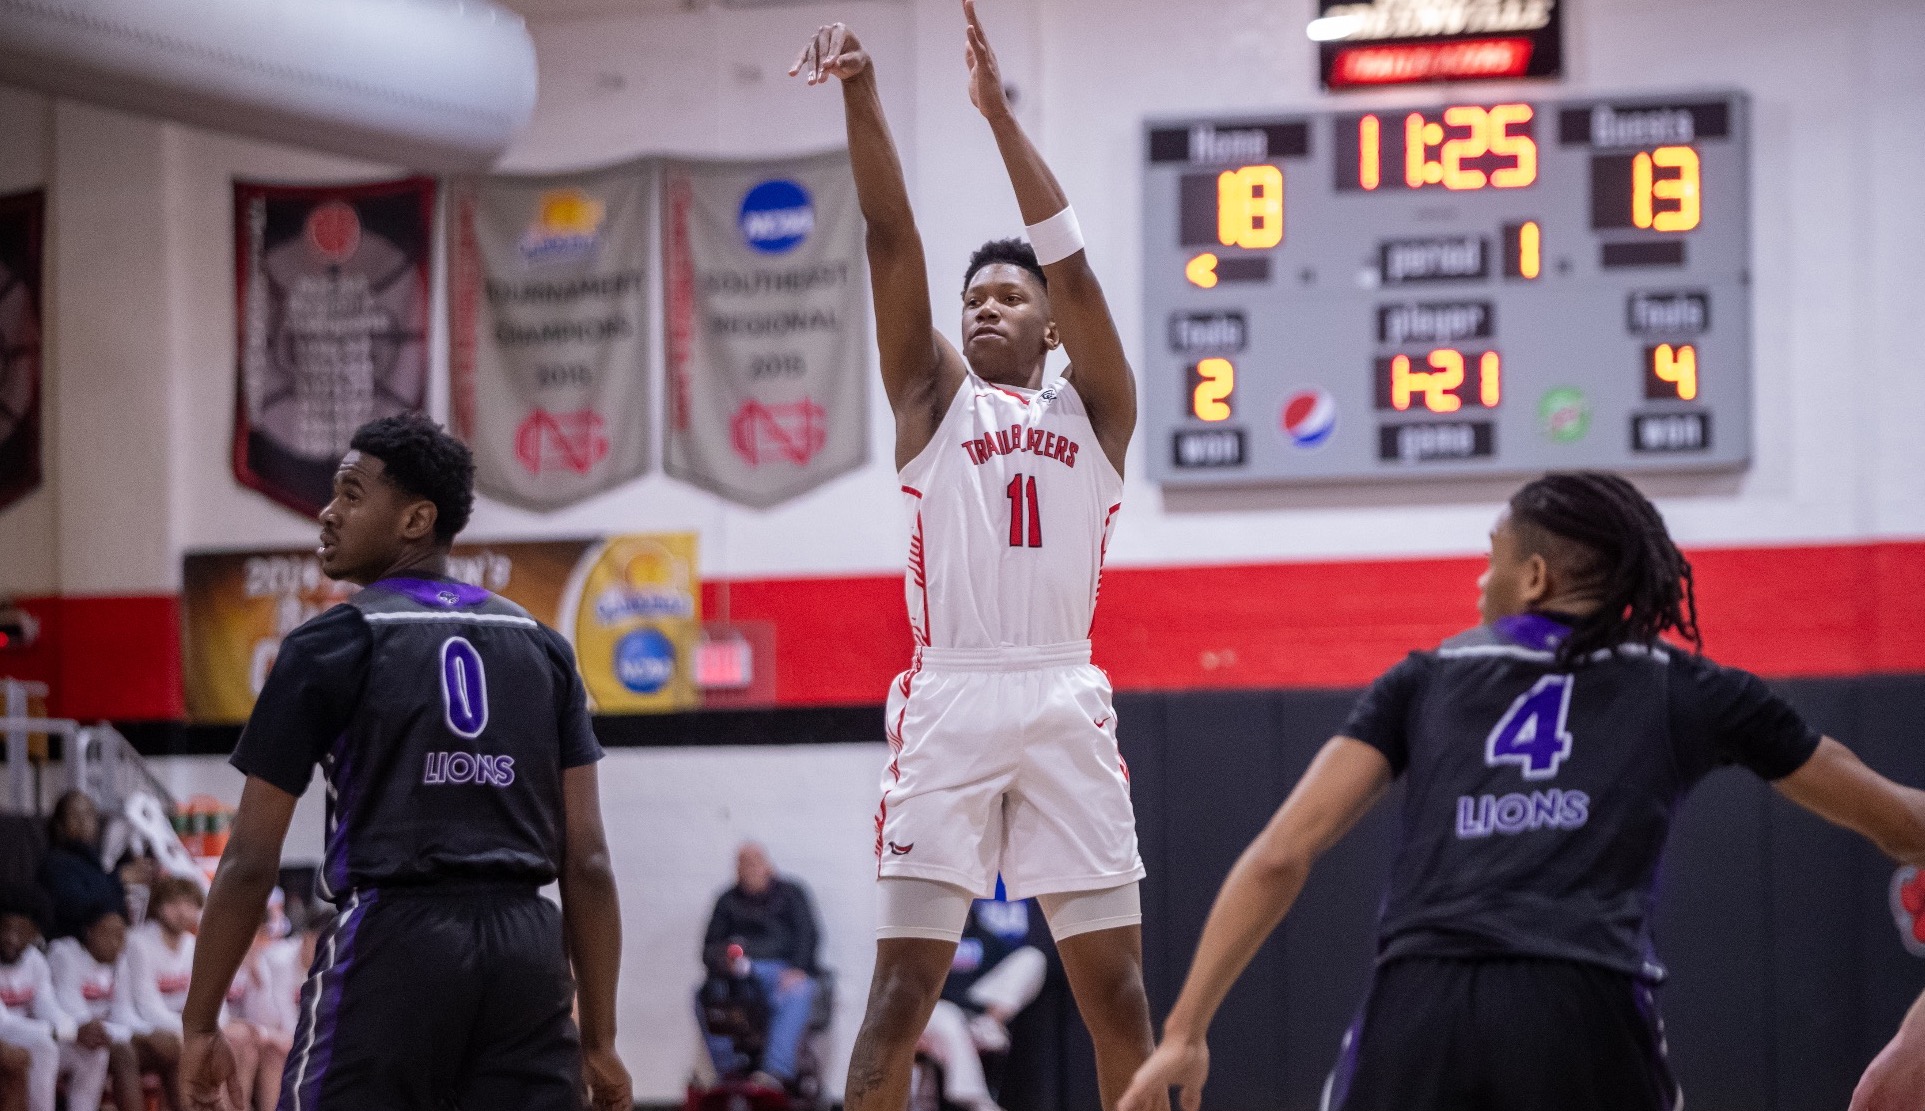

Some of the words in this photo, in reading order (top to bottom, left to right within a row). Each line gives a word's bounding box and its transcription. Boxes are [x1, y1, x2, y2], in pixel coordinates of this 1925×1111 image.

[1358, 103, 1537, 190] 11:25
[1217, 165, 1284, 249] 18
[1632, 145, 1701, 232] 13
[1519, 221, 1540, 279] 1
[495, 312, 634, 346] CHAMPIONS
[711, 309, 840, 338] REGIONAL
[1194, 357, 1235, 422] 2
[1654, 343, 1697, 400] 4
[961, 424, 1080, 468] TRAILBAZERS
[1007, 473, 1042, 548] 11
[441, 636, 489, 738] 0
[1485, 673, 1575, 780] 4
[424, 751, 516, 786] LIONS
[1456, 788, 1591, 839] LIONS
